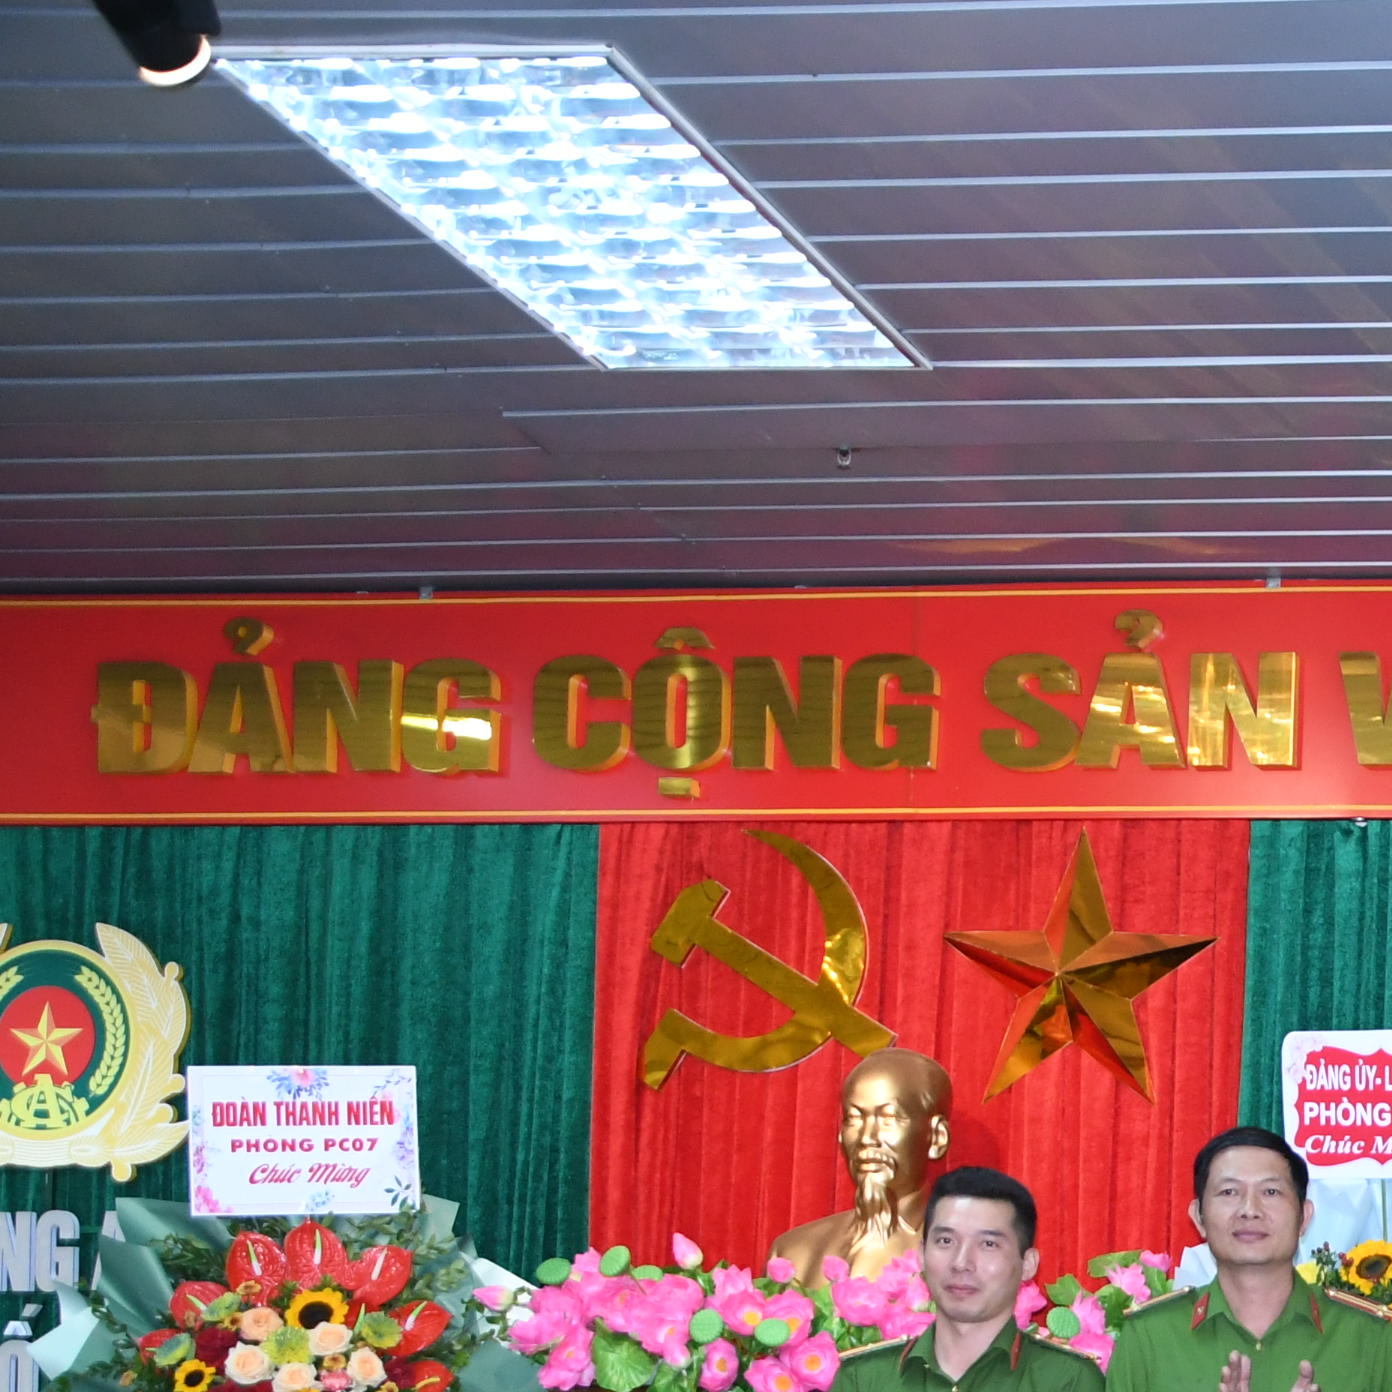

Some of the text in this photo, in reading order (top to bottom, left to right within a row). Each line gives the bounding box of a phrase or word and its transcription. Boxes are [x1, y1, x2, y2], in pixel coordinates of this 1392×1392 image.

[93, 618, 501, 773] ĐẢNG
[531, 626, 940, 796] CỘNG
[981, 609, 1298, 768] SẢN
[1305, 1058, 1350, 1090] ĐẢNG
[211, 1095, 394, 1127] ĐOÀN THANH NIÊN
[1304, 1097, 1391, 1127] PHÒNG
[324, 1138, 379, 1152] PC07
[1305, 1135, 1365, 1154] Chúc
